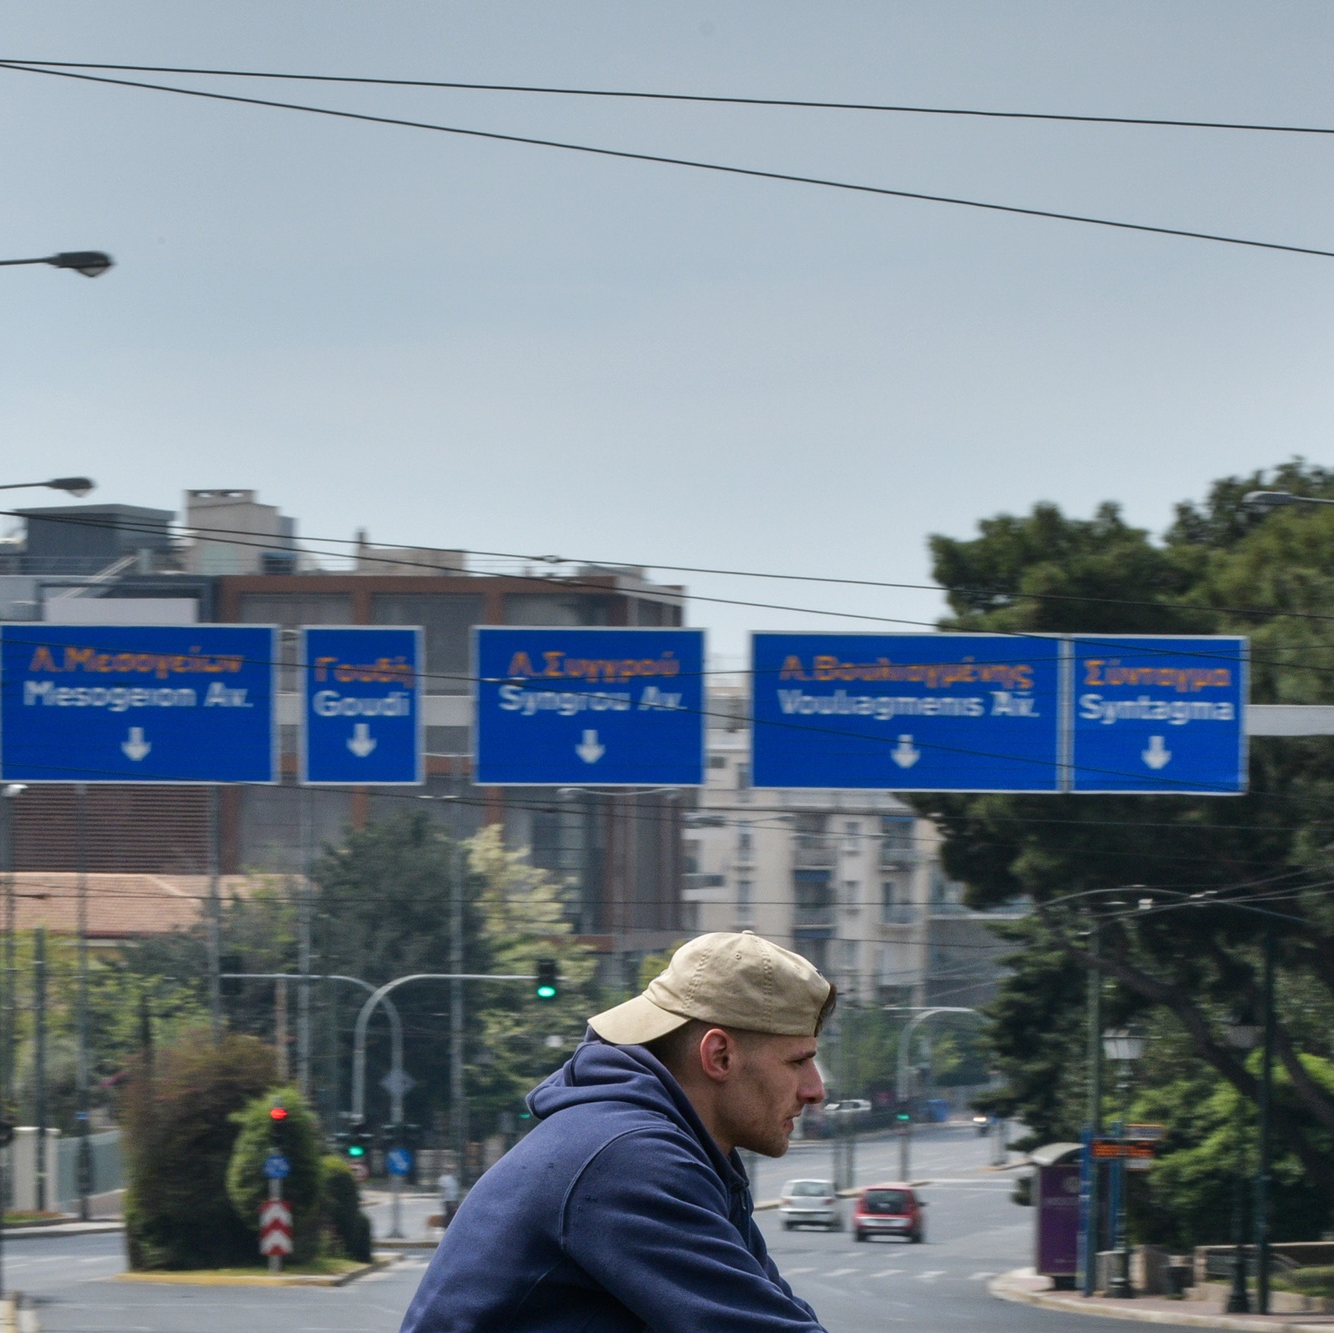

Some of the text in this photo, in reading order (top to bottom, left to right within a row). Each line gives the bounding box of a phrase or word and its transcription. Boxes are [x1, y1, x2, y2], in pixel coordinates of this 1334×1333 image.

[23, 680, 254, 712] Mesogeion Av.
[312, 690, 410, 717] Goudi
[498, 685, 631, 716] Syngrou
[1079, 694, 1235, 725] Syntagma
